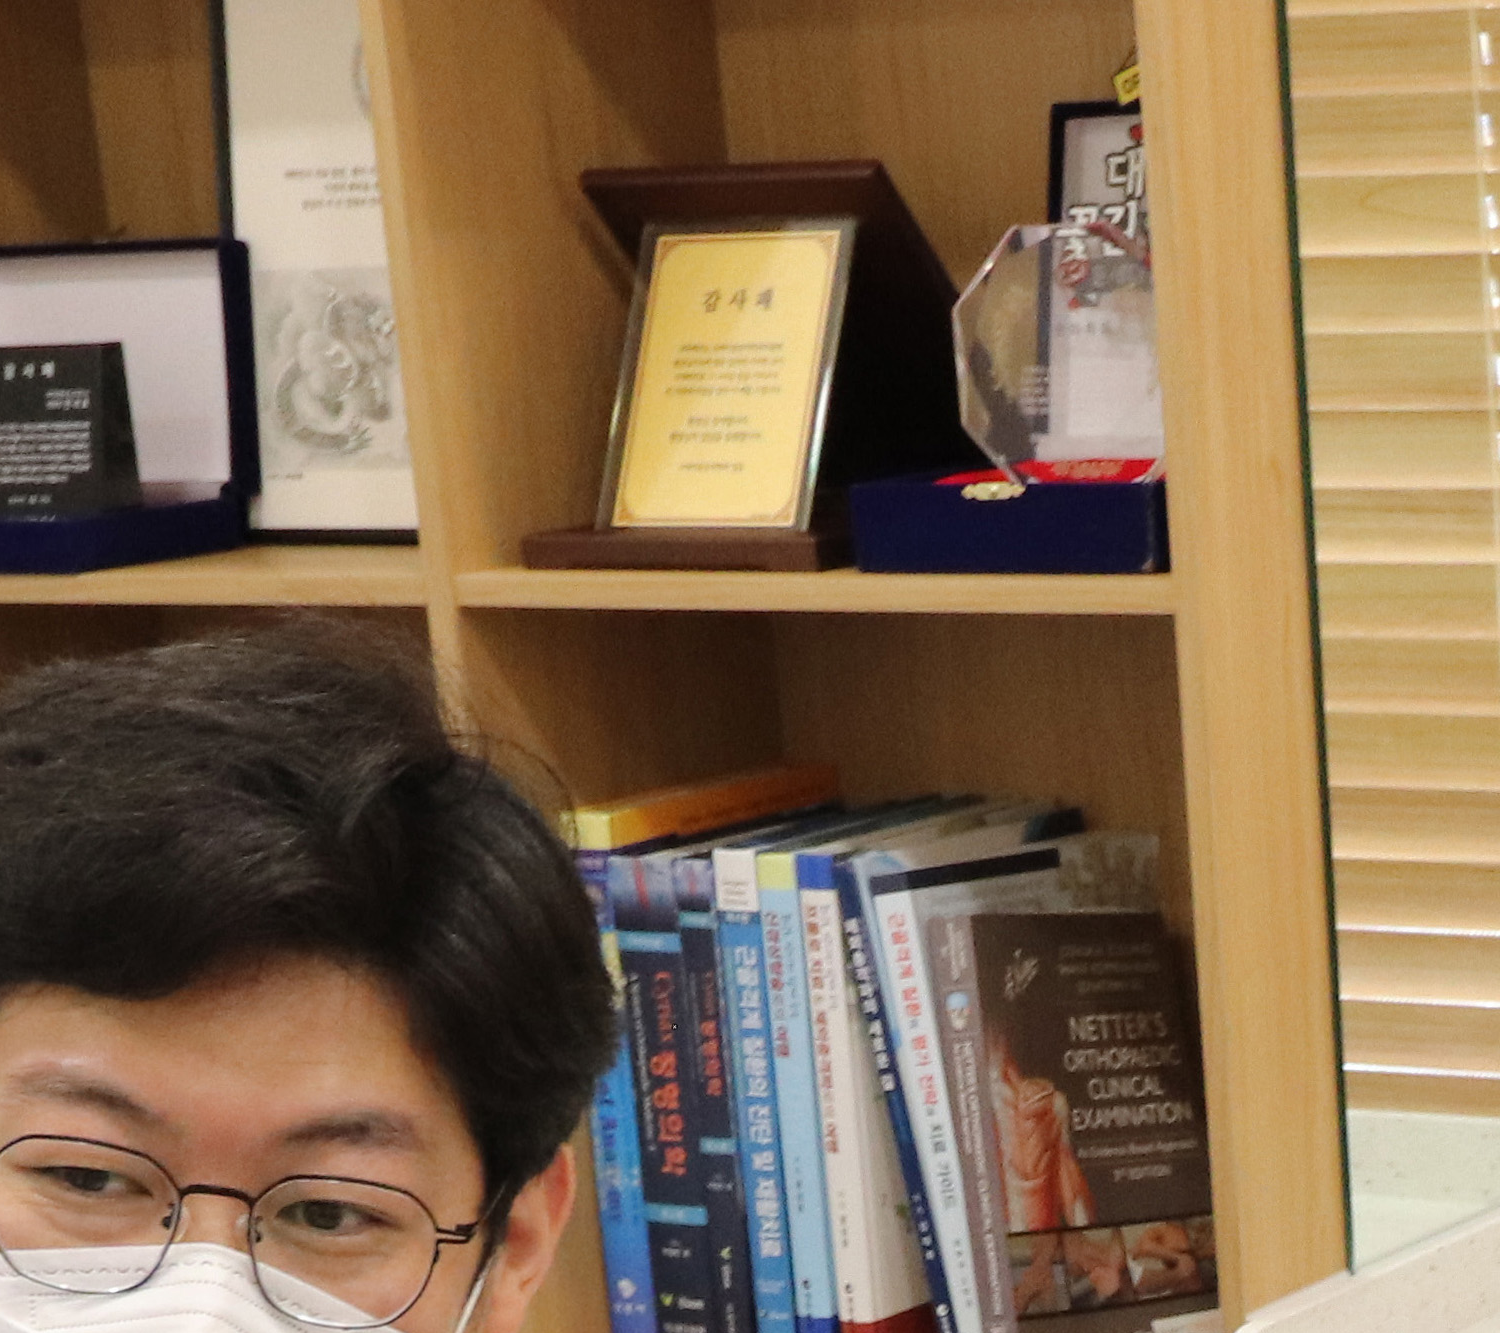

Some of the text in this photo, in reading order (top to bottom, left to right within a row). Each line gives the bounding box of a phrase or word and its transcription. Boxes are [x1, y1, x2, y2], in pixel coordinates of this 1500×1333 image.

[735, 945, 763, 1030] 근골격계
[1068, 1011, 1169, 1042] NETTER'S
[1063, 1045, 1182, 1073] ORTHOPAEDIC
[1087, 1074, 1165, 1101] CLINICAL
[649, 1050, 688, 1177] 정형의학
[747, 1103, 774, 1146] 진단
[1071, 1101, 1193, 1132] EXAMINATION
[750, 1150, 776, 1172] 및
[936, 1161, 957, 1211] 가이드
[755, 1178, 782, 1258] 재활치료
